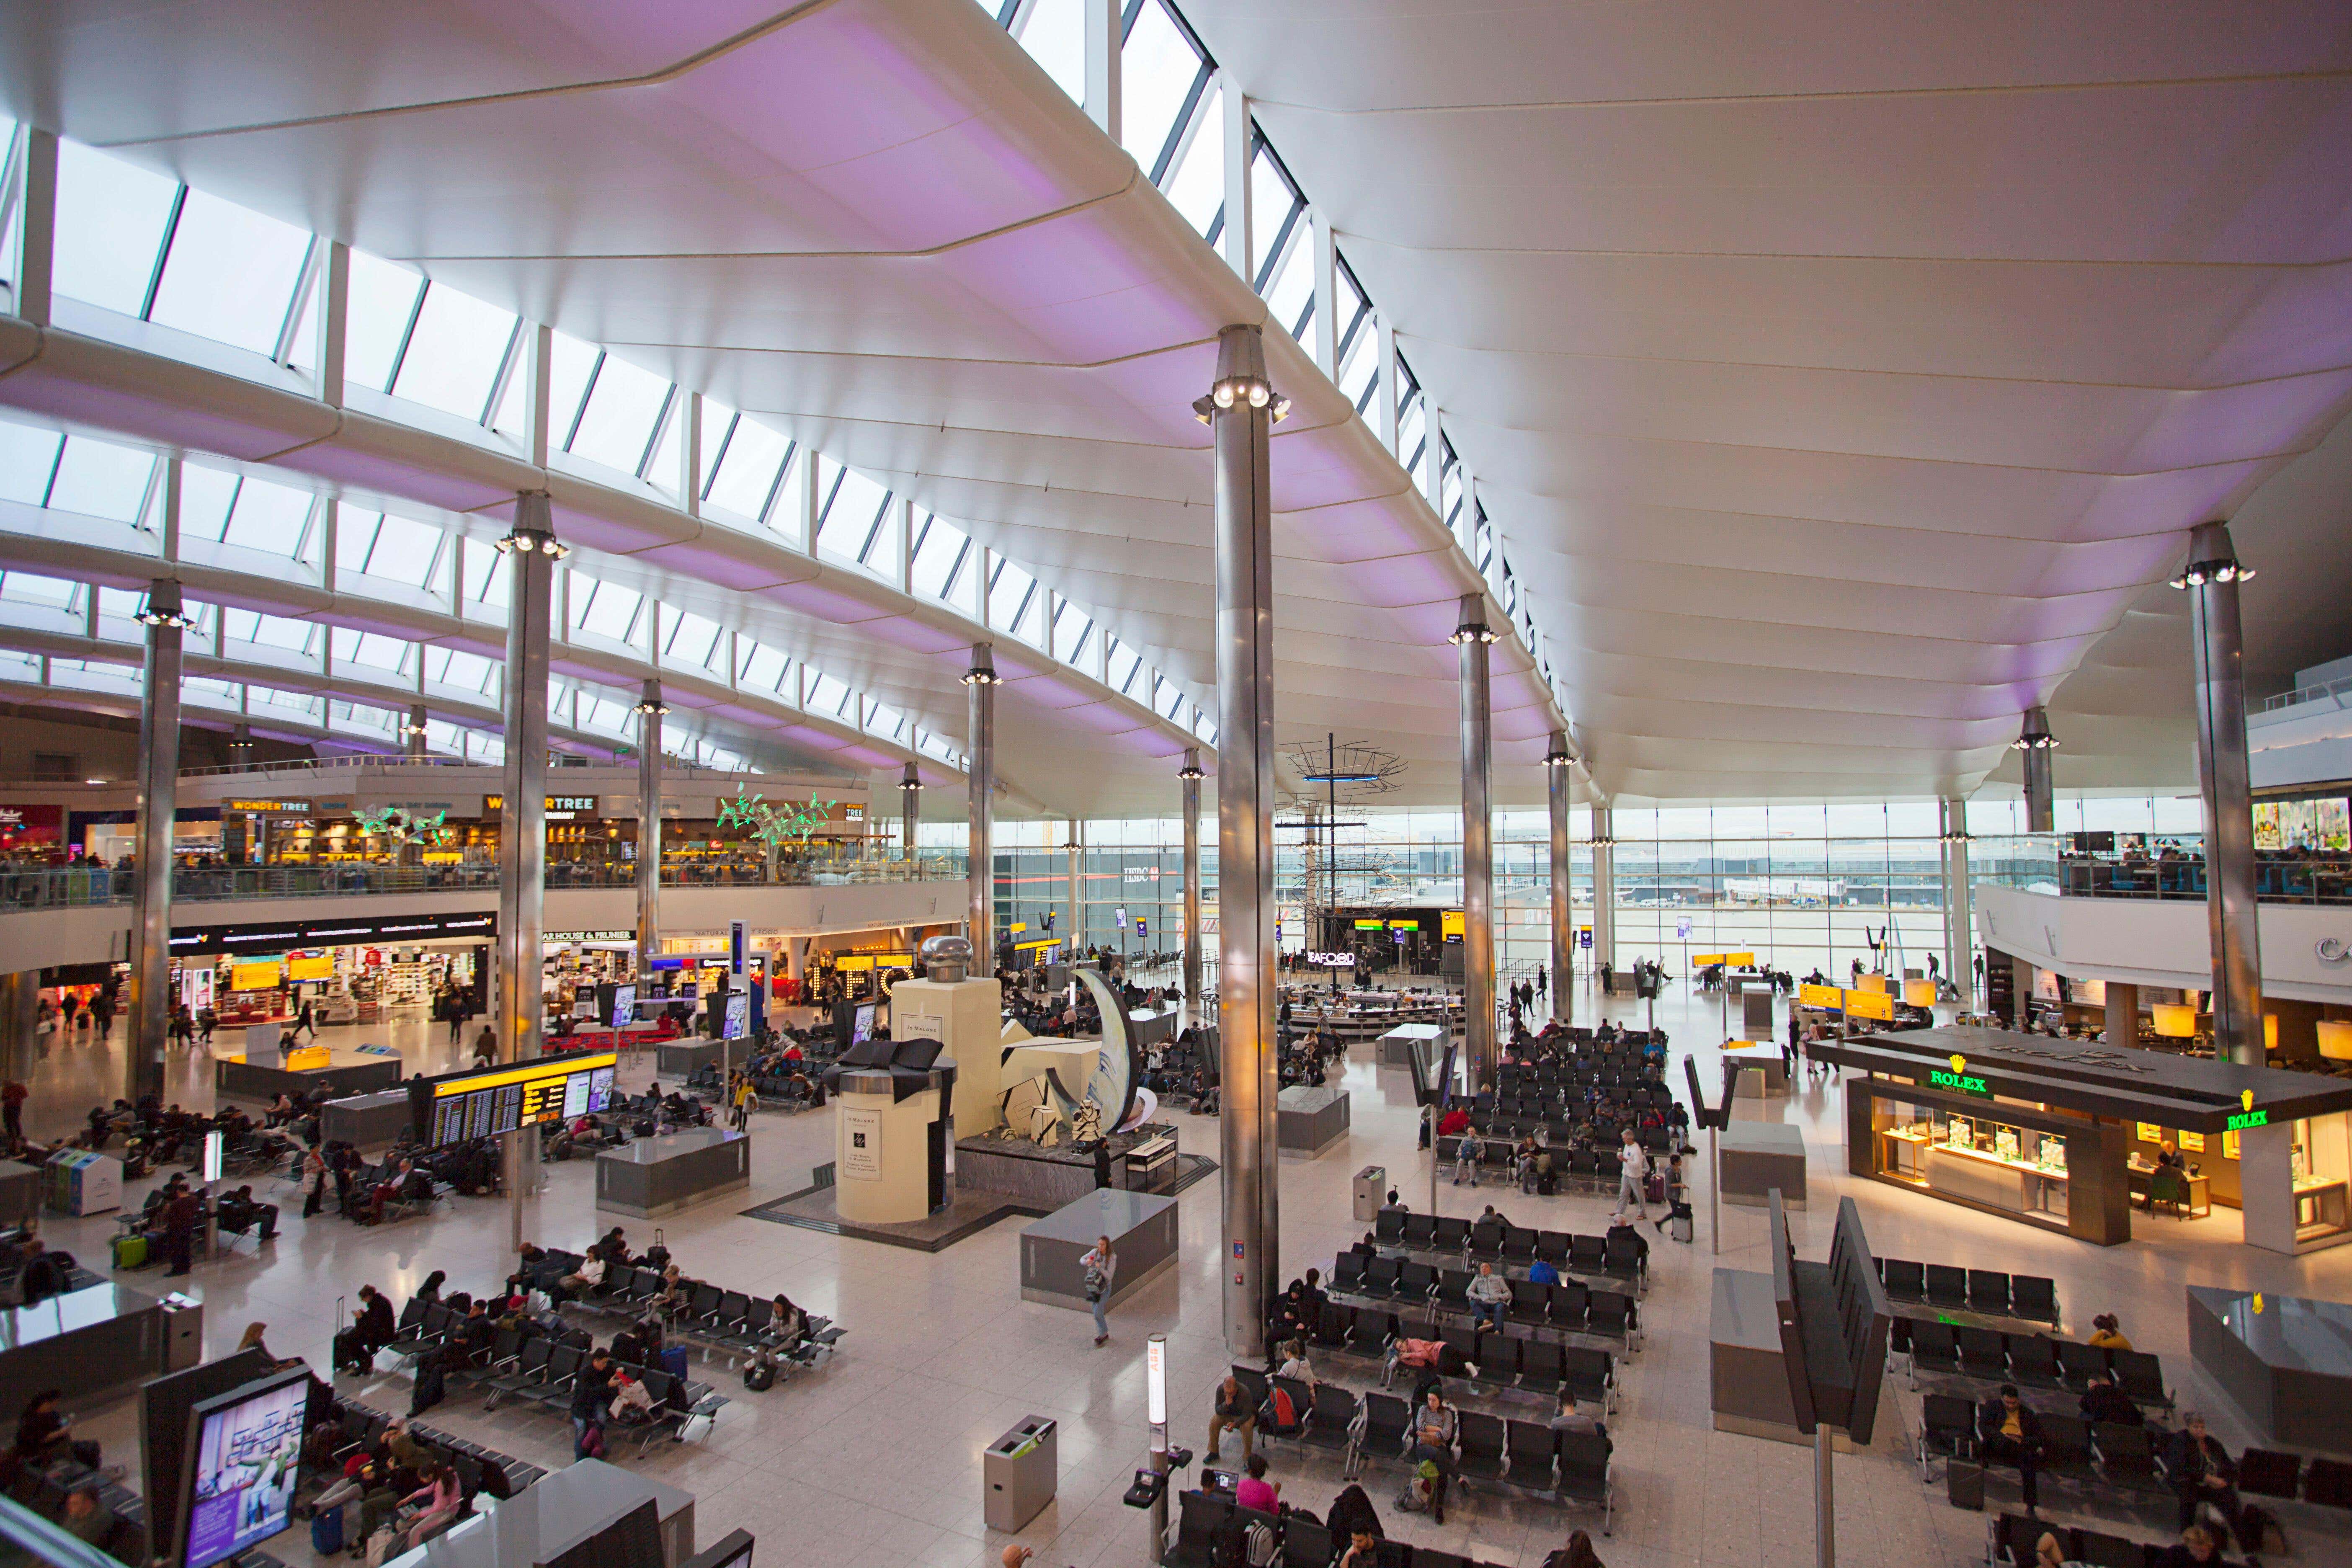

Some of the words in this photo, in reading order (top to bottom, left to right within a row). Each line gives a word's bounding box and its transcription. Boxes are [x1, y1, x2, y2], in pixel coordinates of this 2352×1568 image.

[232, 801, 309, 811] WONDERTREE
[1124, 867, 1148, 882] HSBC
[1931, 1070, 1986, 1092] ROLEX
[2227, 1109, 2268, 1131] ROLEX
